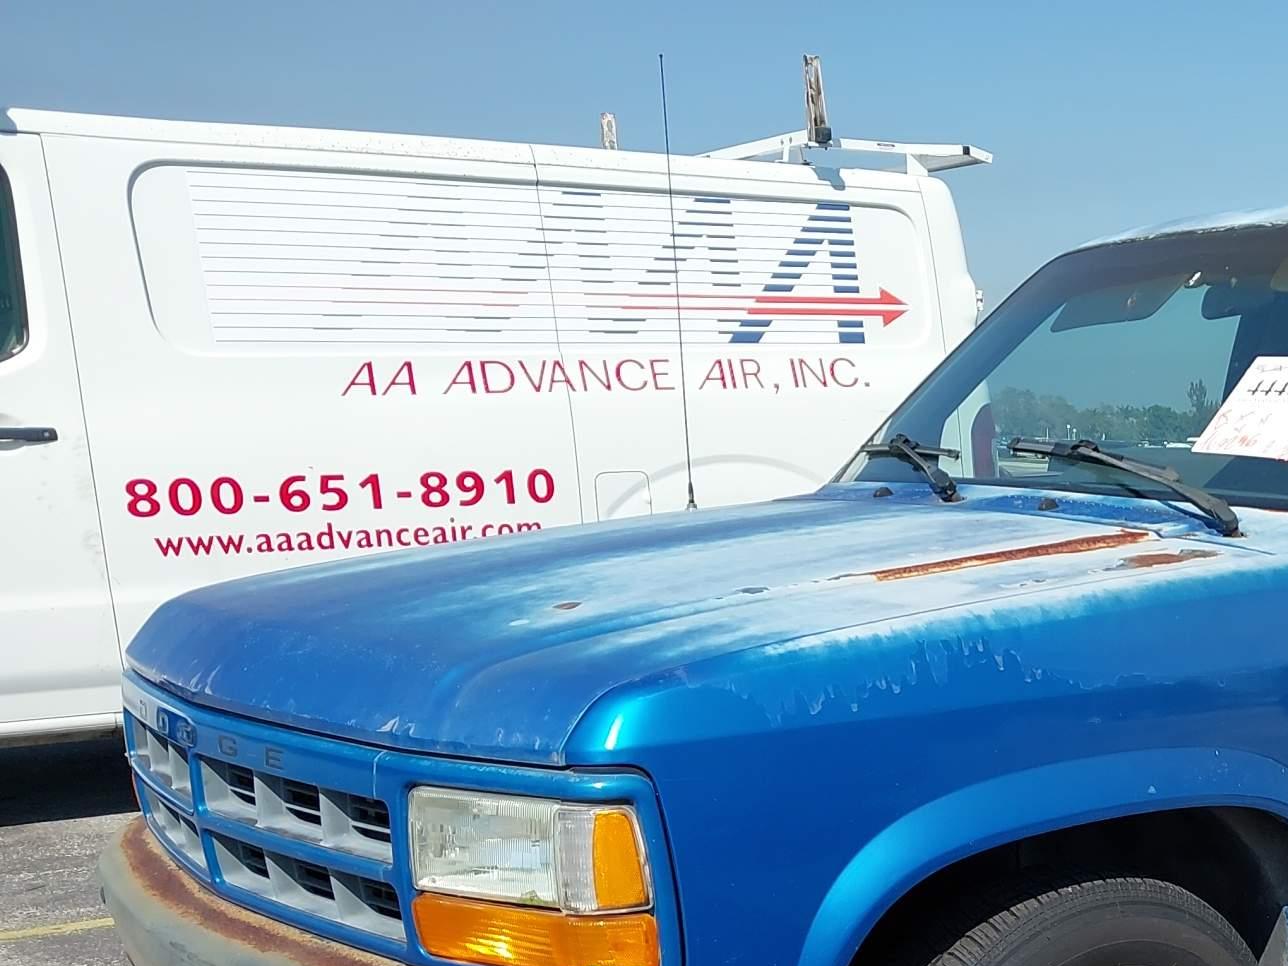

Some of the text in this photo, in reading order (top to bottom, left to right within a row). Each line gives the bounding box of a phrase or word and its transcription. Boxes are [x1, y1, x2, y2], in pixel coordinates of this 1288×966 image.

[342, 357, 872, 397] AA ADVANCE AIR, INC.
[124, 468, 556, 518] 800-651-8910
